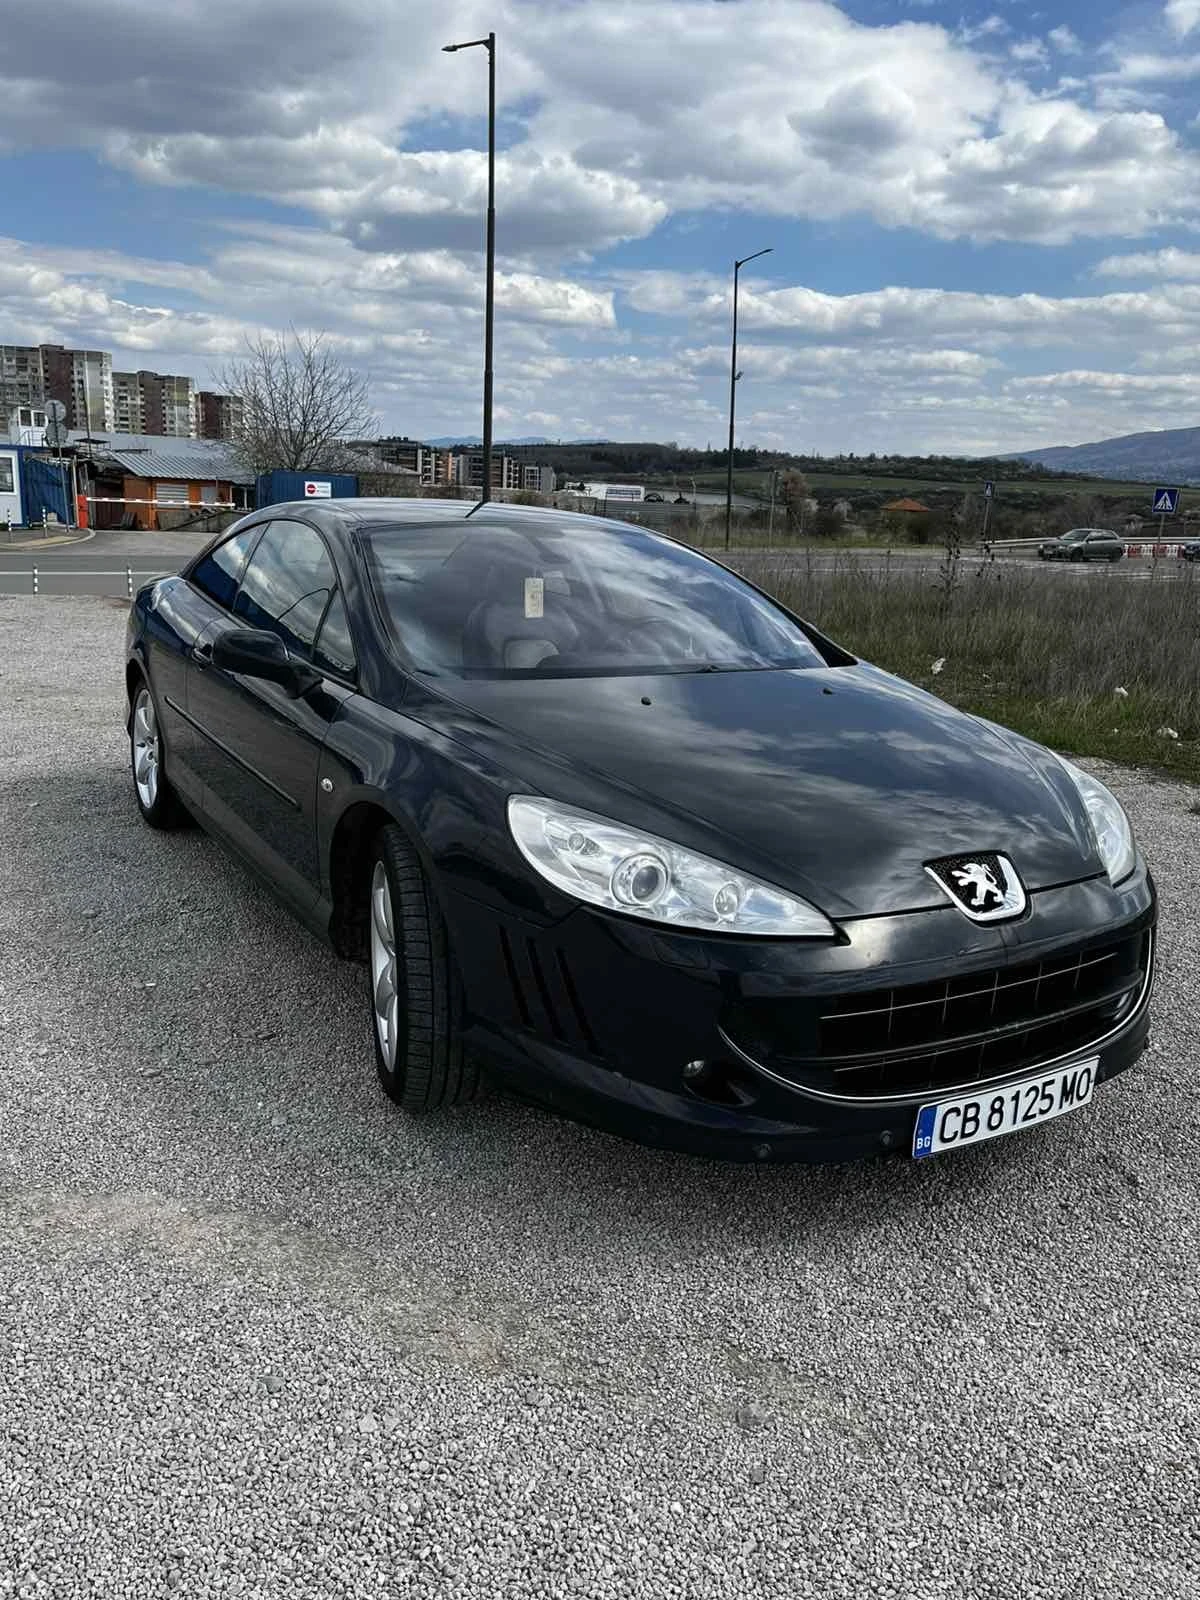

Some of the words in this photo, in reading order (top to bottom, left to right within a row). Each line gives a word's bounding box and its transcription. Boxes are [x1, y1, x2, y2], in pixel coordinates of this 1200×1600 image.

[939, 1102, 981, 1144] CB
[987, 1080, 1055, 1131] 8125
[1059, 1067, 1092, 1110] MO
[916, 1136, 931, 1150] BG
